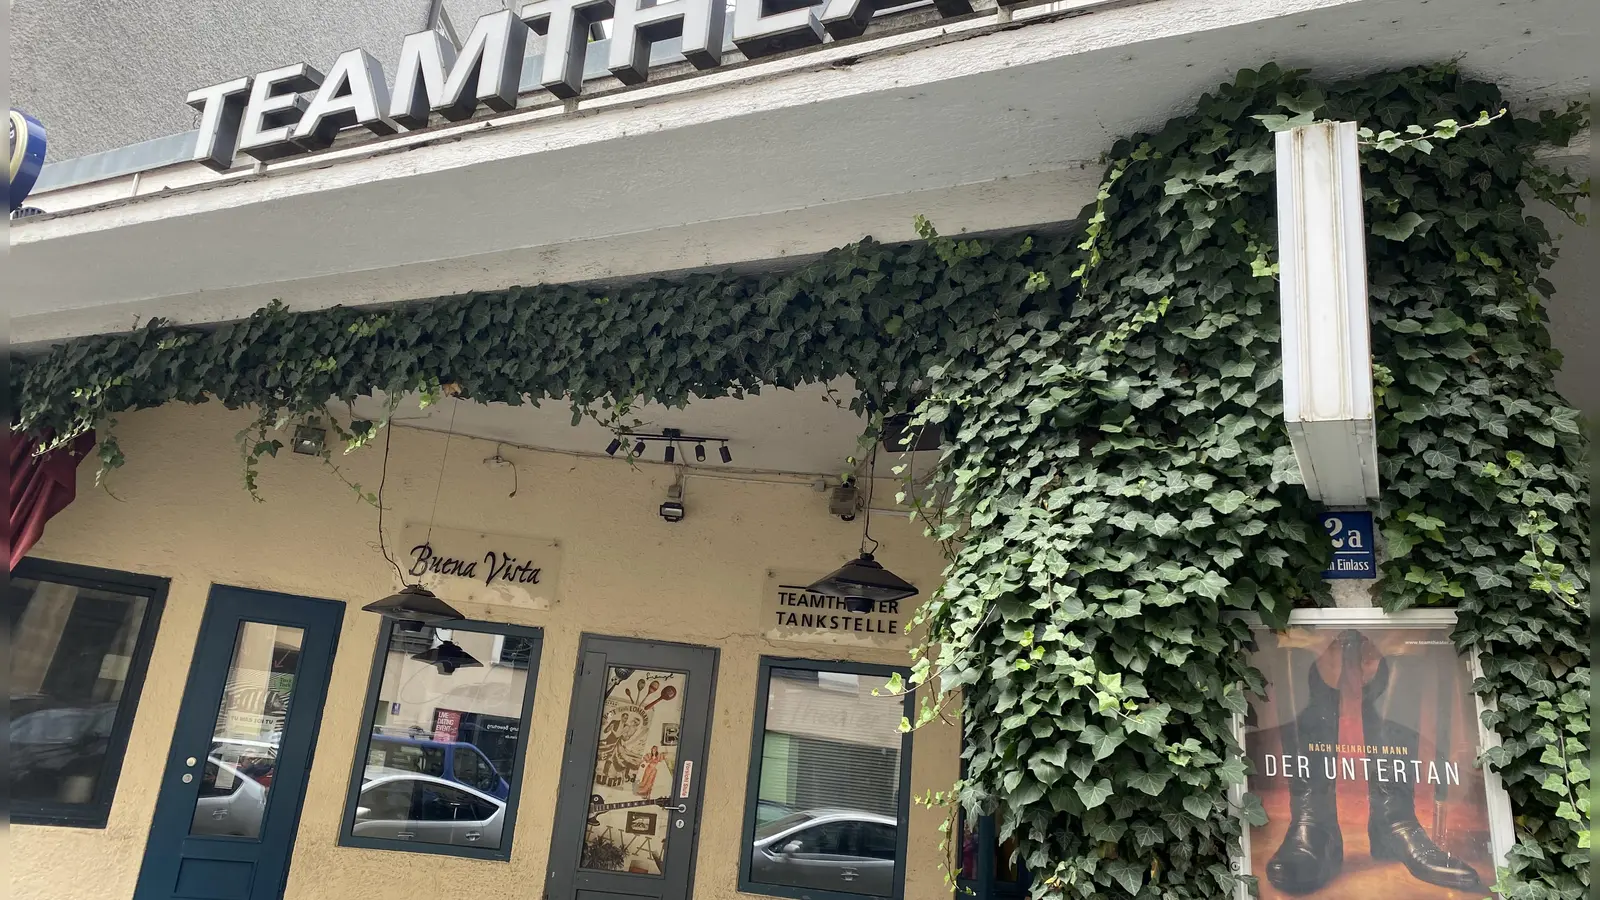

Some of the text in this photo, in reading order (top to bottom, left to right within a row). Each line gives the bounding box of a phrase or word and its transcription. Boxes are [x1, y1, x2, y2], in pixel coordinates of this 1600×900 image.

[1324, 517, 1363, 548] 2a
[408, 543, 541, 587] Buena Vista
[1337, 558, 1369, 571] Einlass
[776, 611, 898, 634] TANKSTELLE
[1308, 743, 1408, 755] NACH HEINRICH MANN
[1264, 754, 1461, 786] DER UNTERTAN
